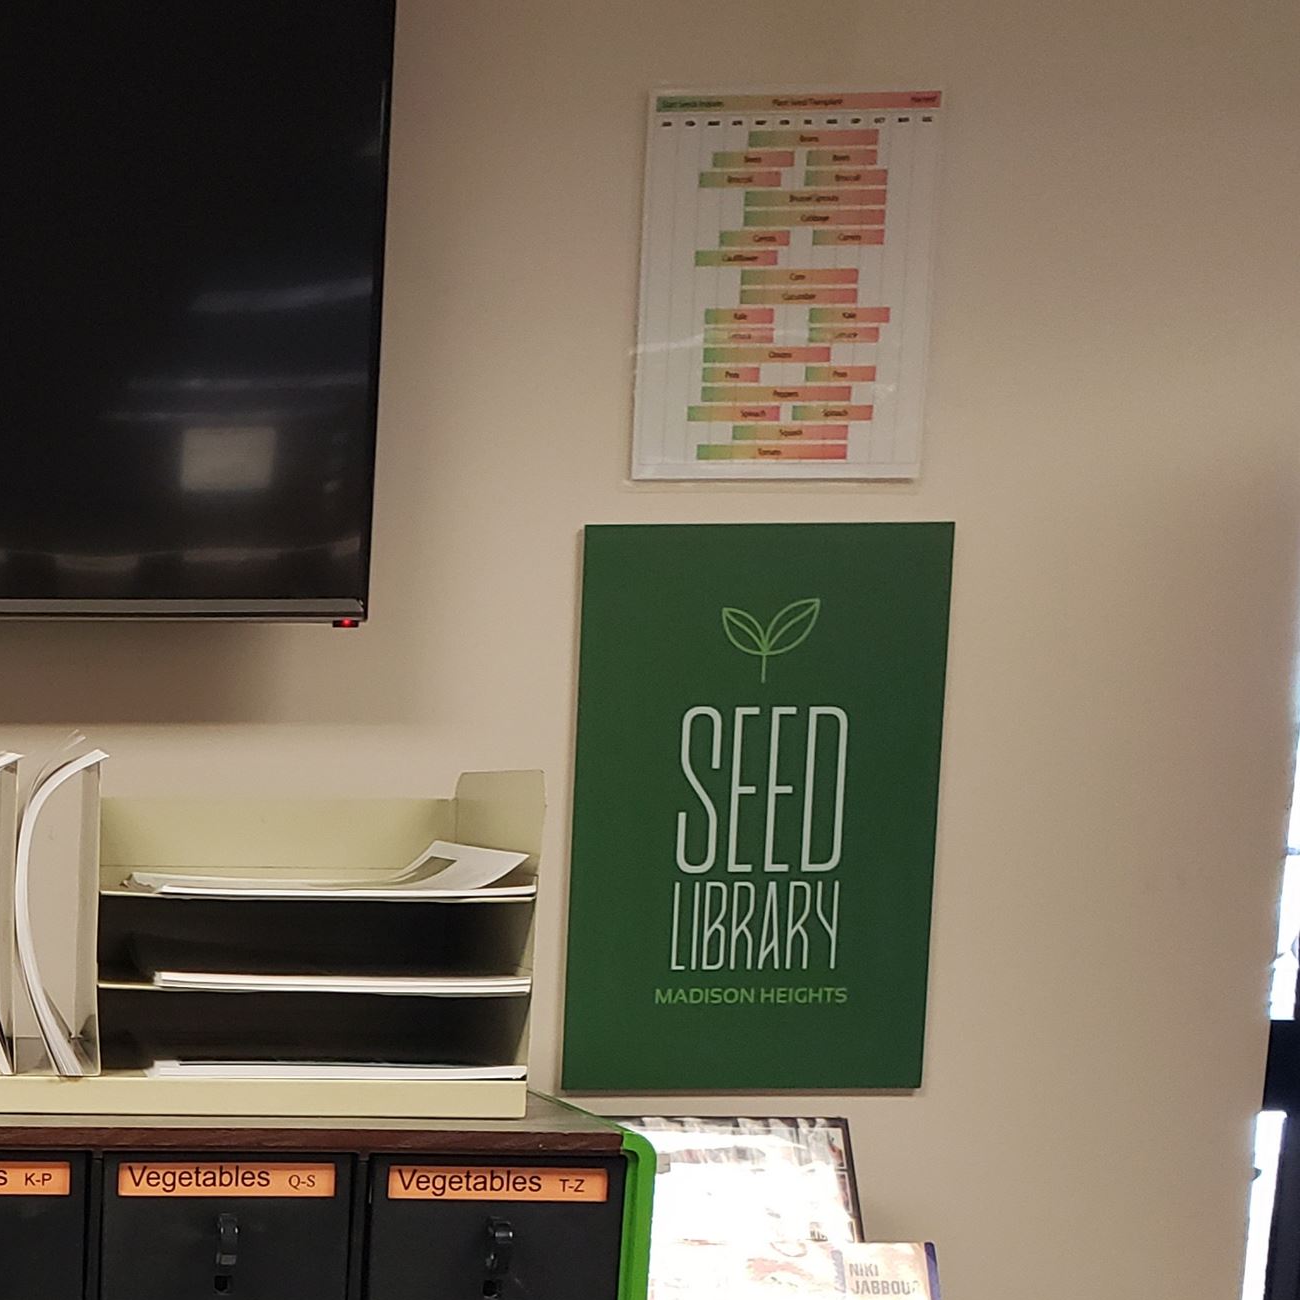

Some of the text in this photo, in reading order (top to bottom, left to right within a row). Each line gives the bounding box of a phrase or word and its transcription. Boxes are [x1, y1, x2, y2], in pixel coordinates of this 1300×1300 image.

[782, 292, 816, 300] Cucumber
[734, 312, 747, 321] Kale
[741, 409, 766, 418] Spinach
[823, 408, 848, 418] Spinach
[675, 706, 848, 874] SEED
[670, 880, 840, 970] LIBRARY
[654, 987, 847, 1004] MADISON HEIGHTS
[24, 1172, 52, 1186] K-P
[127, 1165, 317, 1193] Vegetables Q-S
[398, 1169, 585, 1197] Vegetables T-Z
[849, 1263, 879, 1277] NIKI
